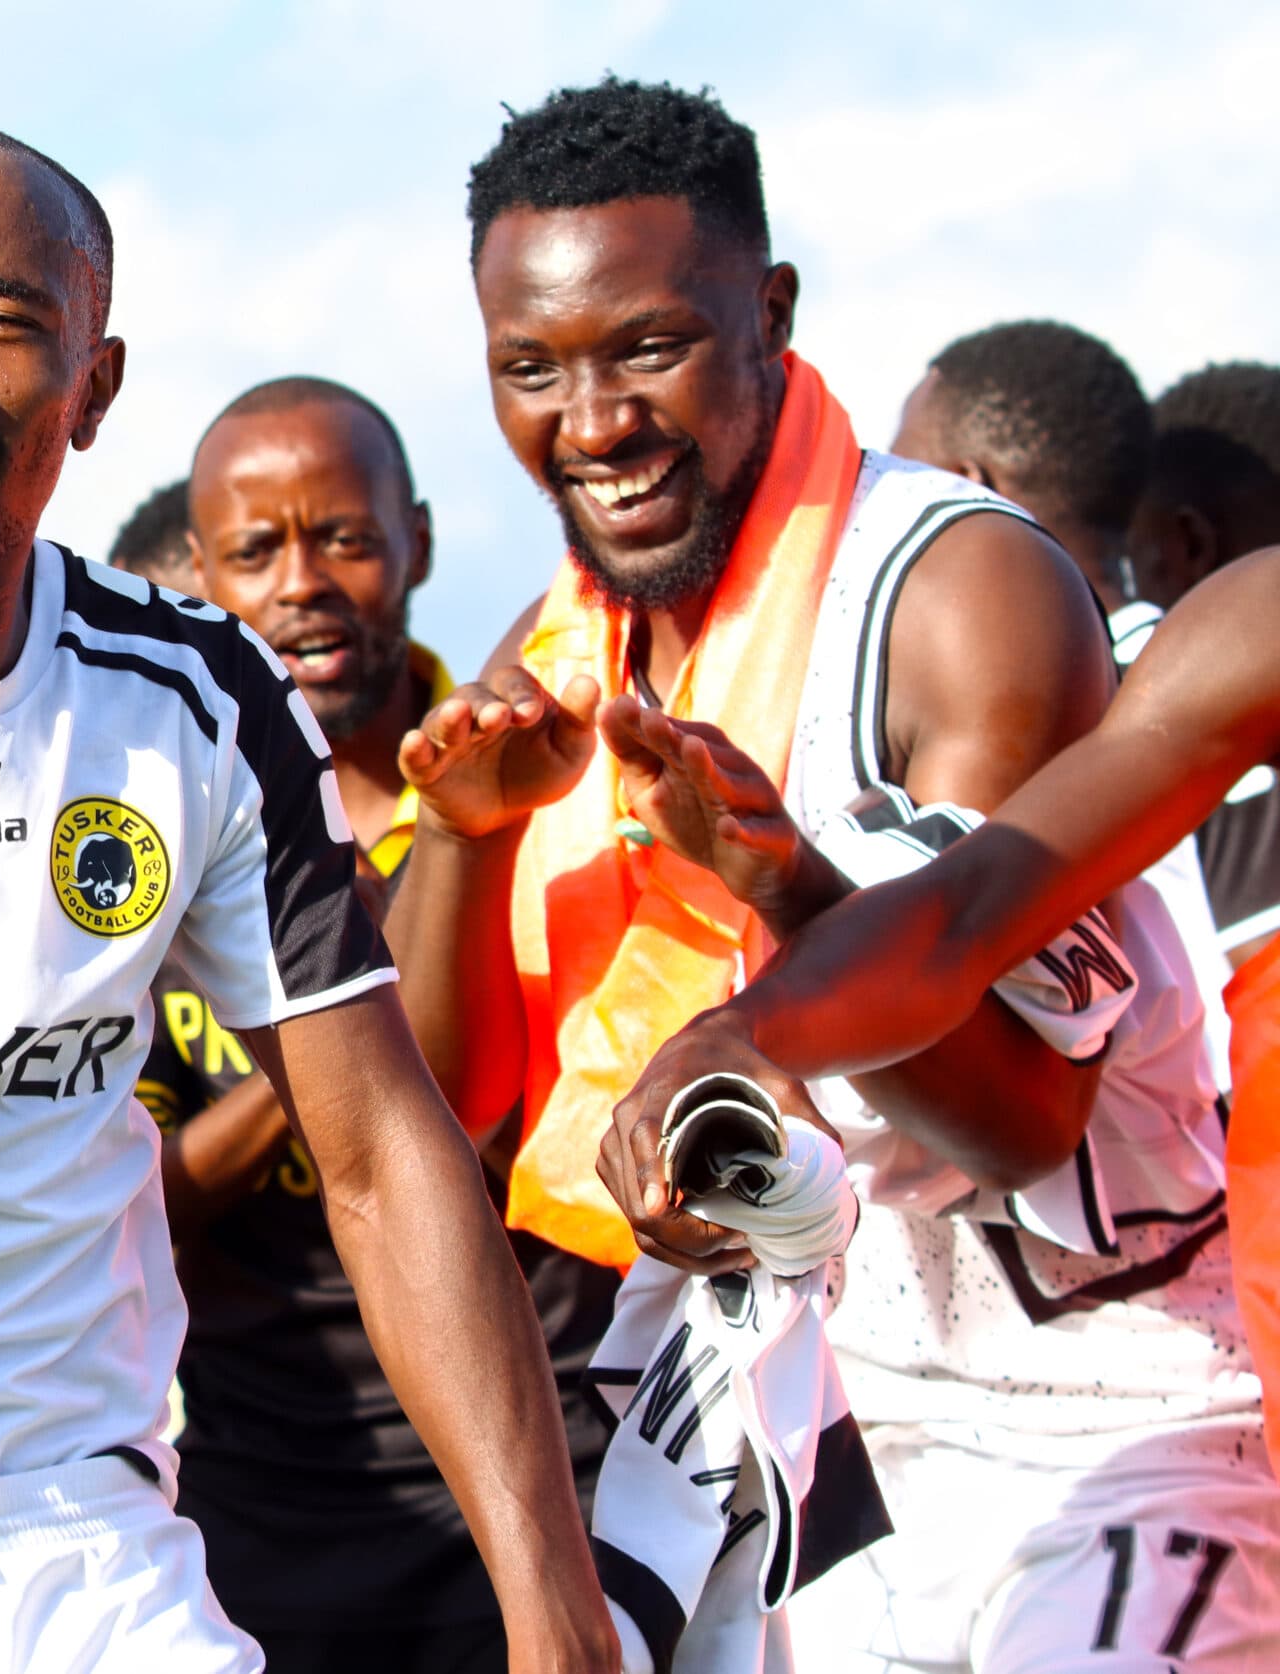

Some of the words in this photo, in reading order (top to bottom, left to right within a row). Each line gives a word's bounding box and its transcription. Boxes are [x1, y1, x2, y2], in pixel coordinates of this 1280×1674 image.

[55, 808, 155, 860] TUSKER
[56, 865, 70, 882] 19
[143, 859, 162, 877] 69
[62, 888, 132, 928] FOOTBALL
[134, 882, 159, 917] CLUB
[1090, 1524, 1238, 1661] 17
